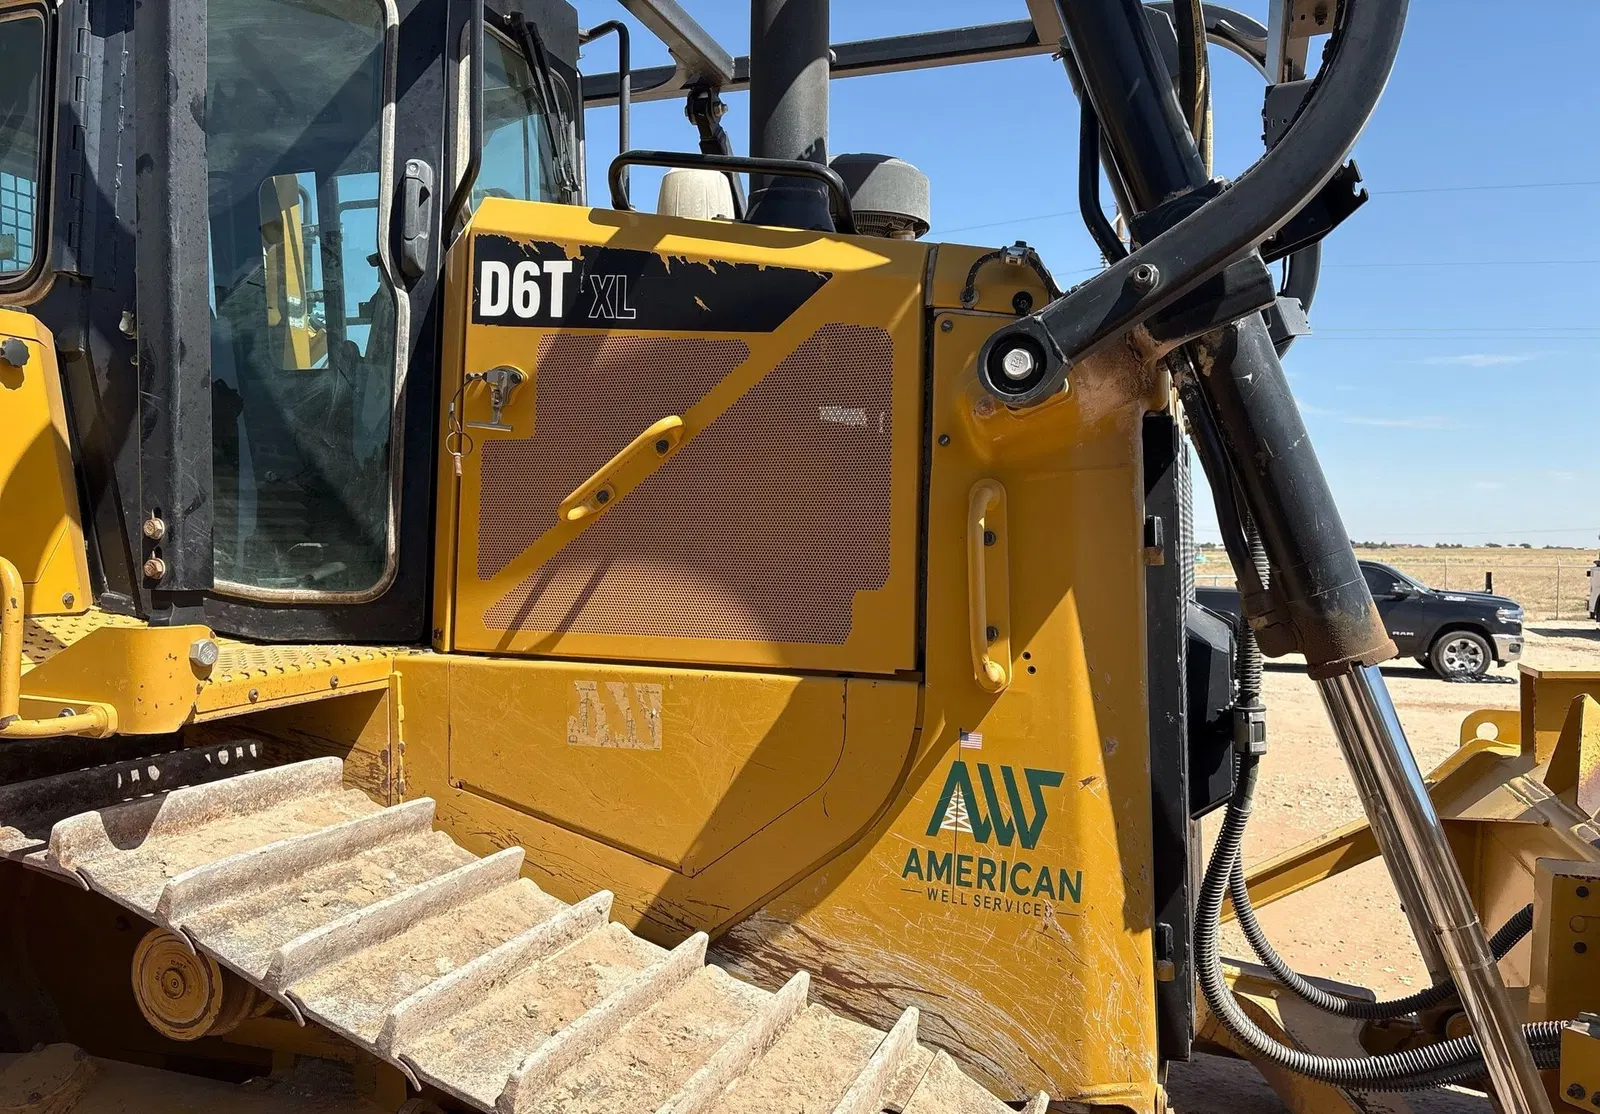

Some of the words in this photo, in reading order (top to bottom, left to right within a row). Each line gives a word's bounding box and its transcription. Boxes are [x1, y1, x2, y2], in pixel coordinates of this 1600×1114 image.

[480, 260, 573, 318] D6T
[588, 274, 637, 319] XL
[901, 848, 1083, 903] AMERICAN
[927, 888, 968, 906] WELL
